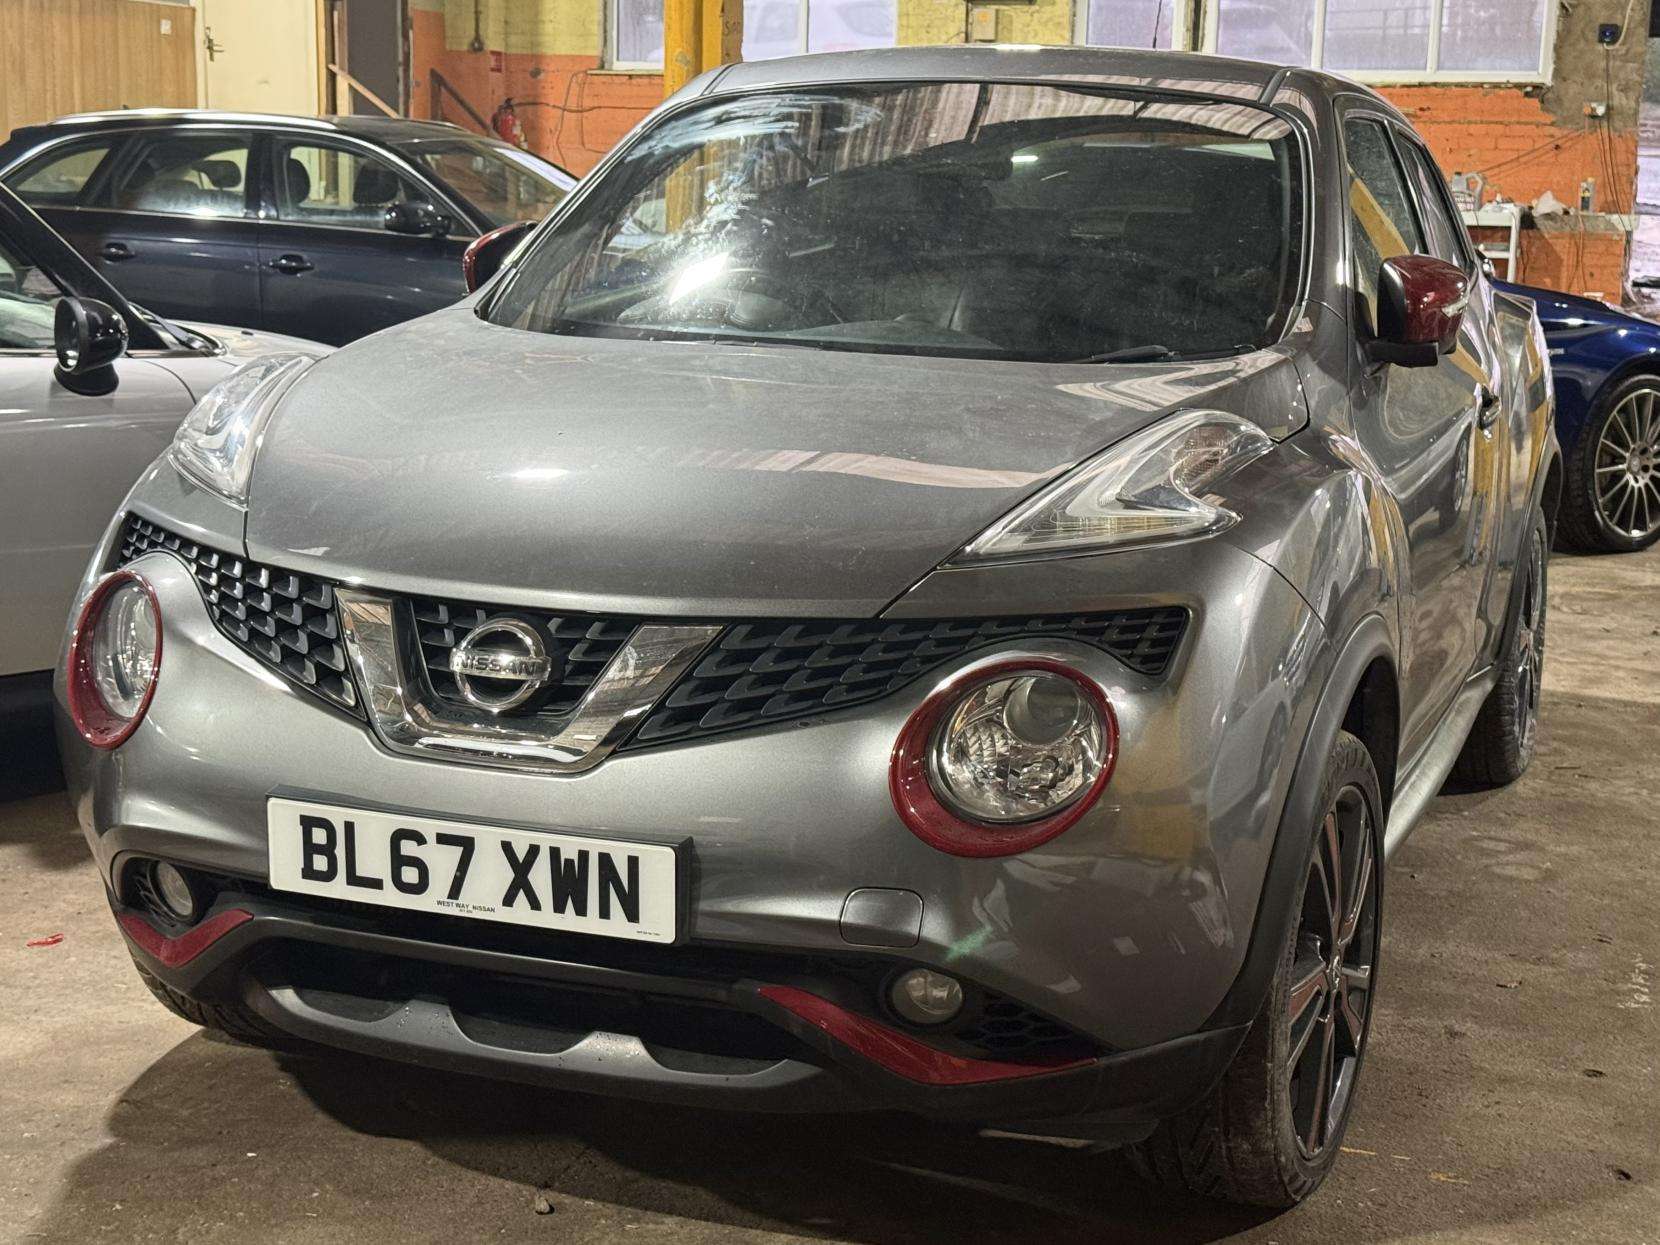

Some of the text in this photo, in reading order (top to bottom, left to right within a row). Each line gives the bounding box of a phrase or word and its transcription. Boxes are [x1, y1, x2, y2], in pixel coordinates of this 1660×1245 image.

[300, 814, 639, 924] BL67 XWN
[472, 904, 496, 912] NISSAN
